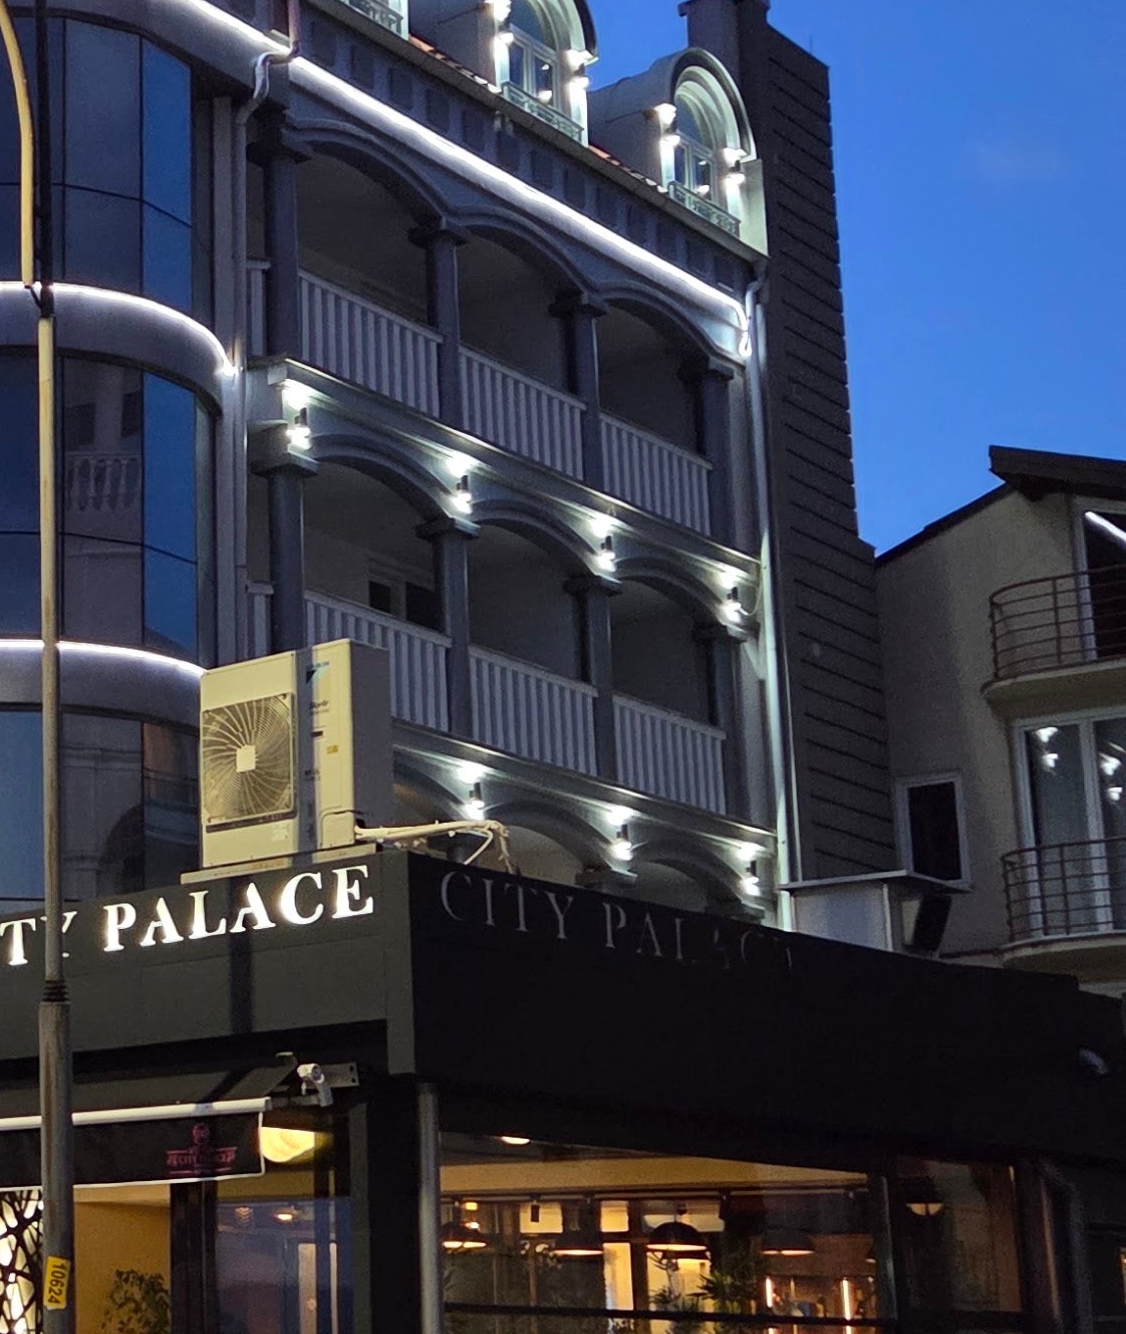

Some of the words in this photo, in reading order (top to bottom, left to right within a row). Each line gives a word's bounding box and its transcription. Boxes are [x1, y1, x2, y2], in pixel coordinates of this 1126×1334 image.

[103, 864, 374, 953] PALACE
[440, 870, 574, 940] CITY
[48, 1263, 67, 1304] 10624
